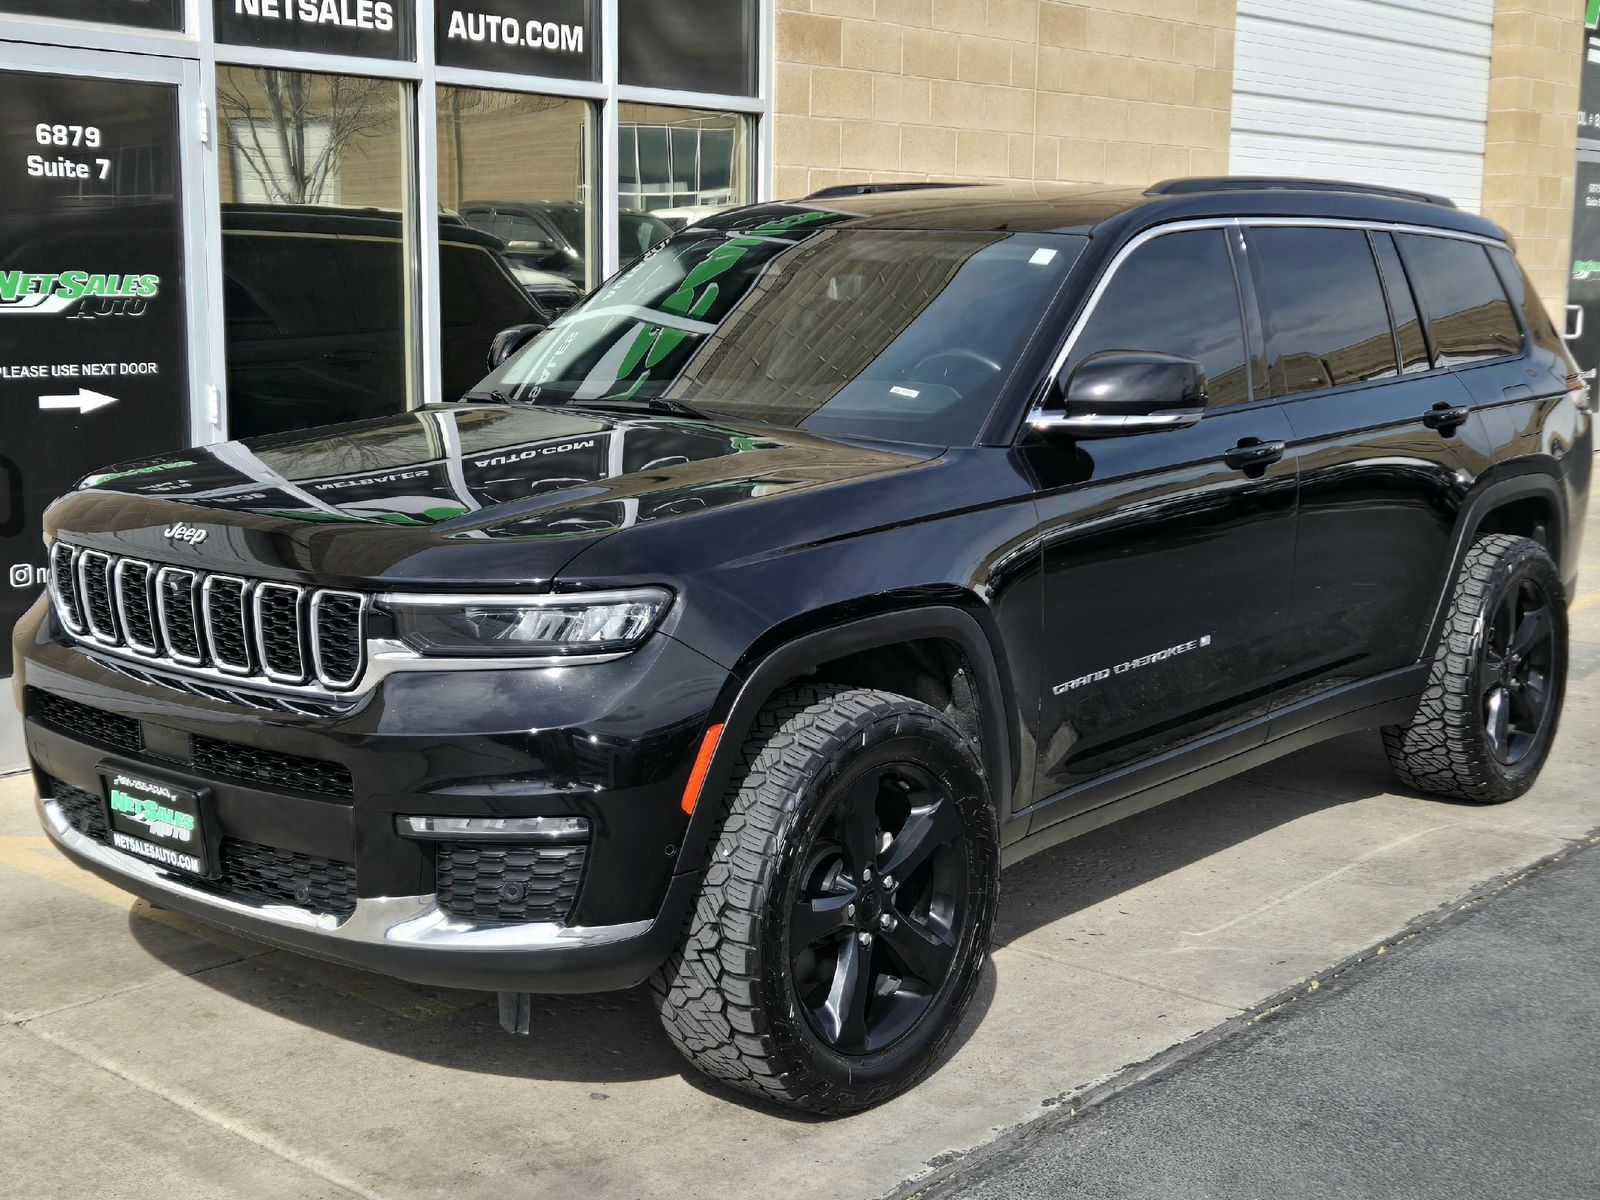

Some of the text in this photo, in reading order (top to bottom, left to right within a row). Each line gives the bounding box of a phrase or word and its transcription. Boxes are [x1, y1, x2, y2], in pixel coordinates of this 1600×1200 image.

[447, 10, 584, 53] AUTO.COM
[35, 123, 101, 148] 6879
[26, 154, 111, 180] Suite 7
[0, 362, 158, 378] LEASE USE NEXT DOOR
[164, 522, 208, 545] Jeep
[1052, 639, 1197, 695] GRAND CHEROKEE
[149, 821, 191, 842] AUTO
[113, 833, 200, 873] NETSALESAUTO.COM
